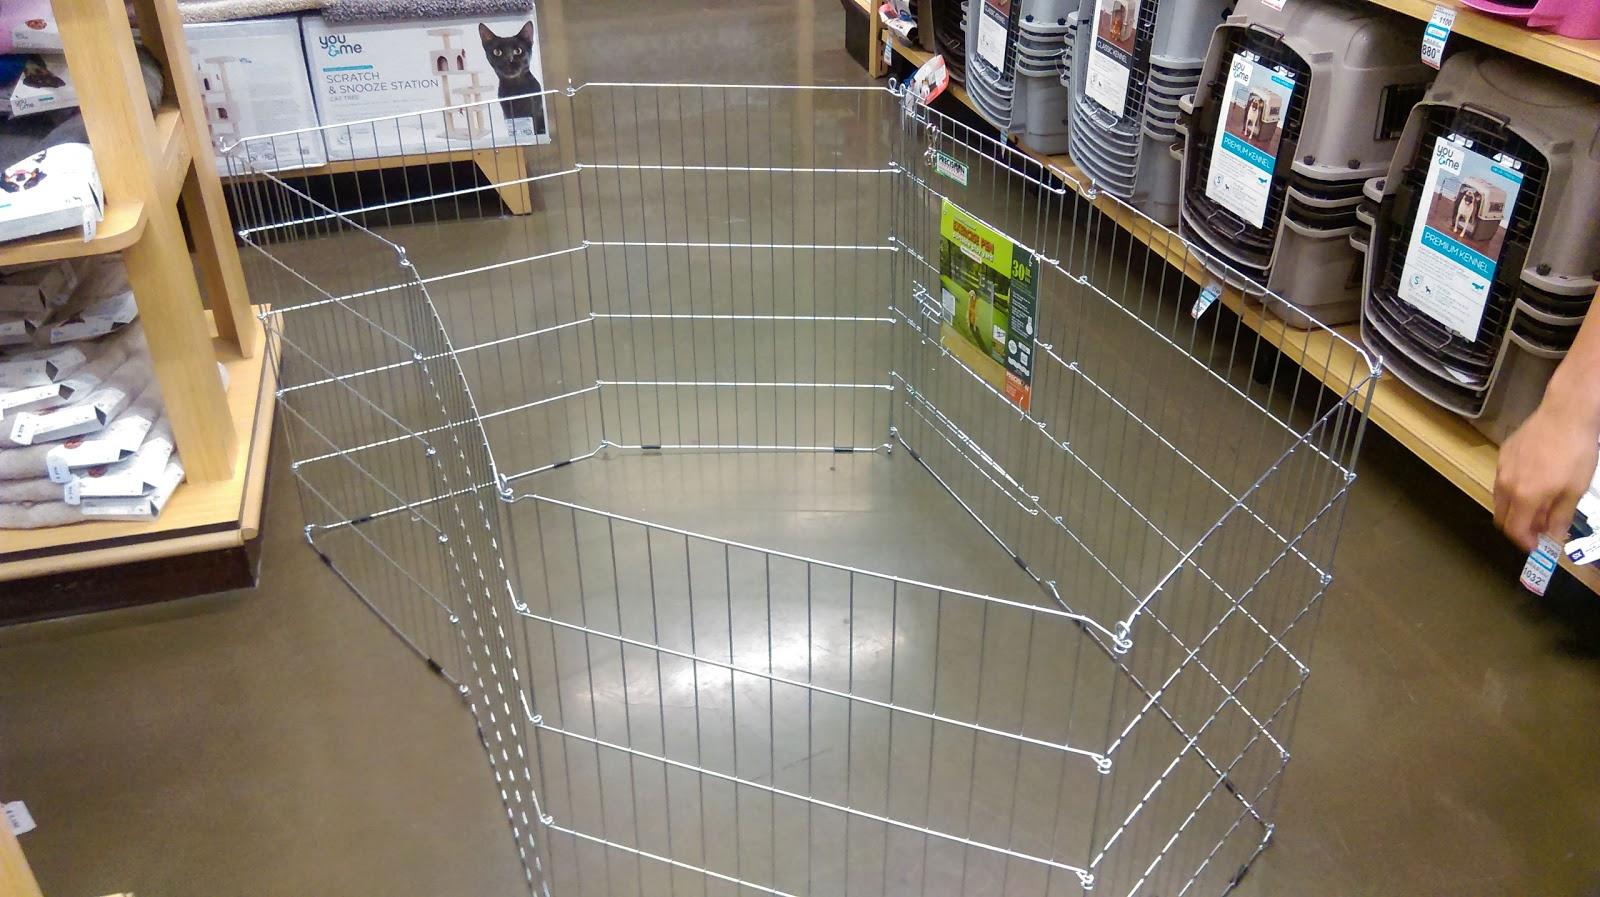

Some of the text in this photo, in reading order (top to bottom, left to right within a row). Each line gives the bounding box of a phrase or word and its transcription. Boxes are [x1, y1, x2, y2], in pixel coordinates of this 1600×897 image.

[318, 34, 347, 49] you
[1097, 40, 1128, 64] CLASSIC KENNEL
[1233, 61, 1246, 73] you
[326, 71, 380, 84] SCRATCH
[328, 79, 439, 95] & SNOOZE STATION
[1223, 136, 1249, 158] PREMIUM
[1248, 150, 1270, 169] KENNEL
[1436, 144, 1454, 158] you
[1424, 231, 1458, 258] PREMIUM
[1458, 250, 1489, 274] KENNEL
[1012, 259, 1025, 282] 30
